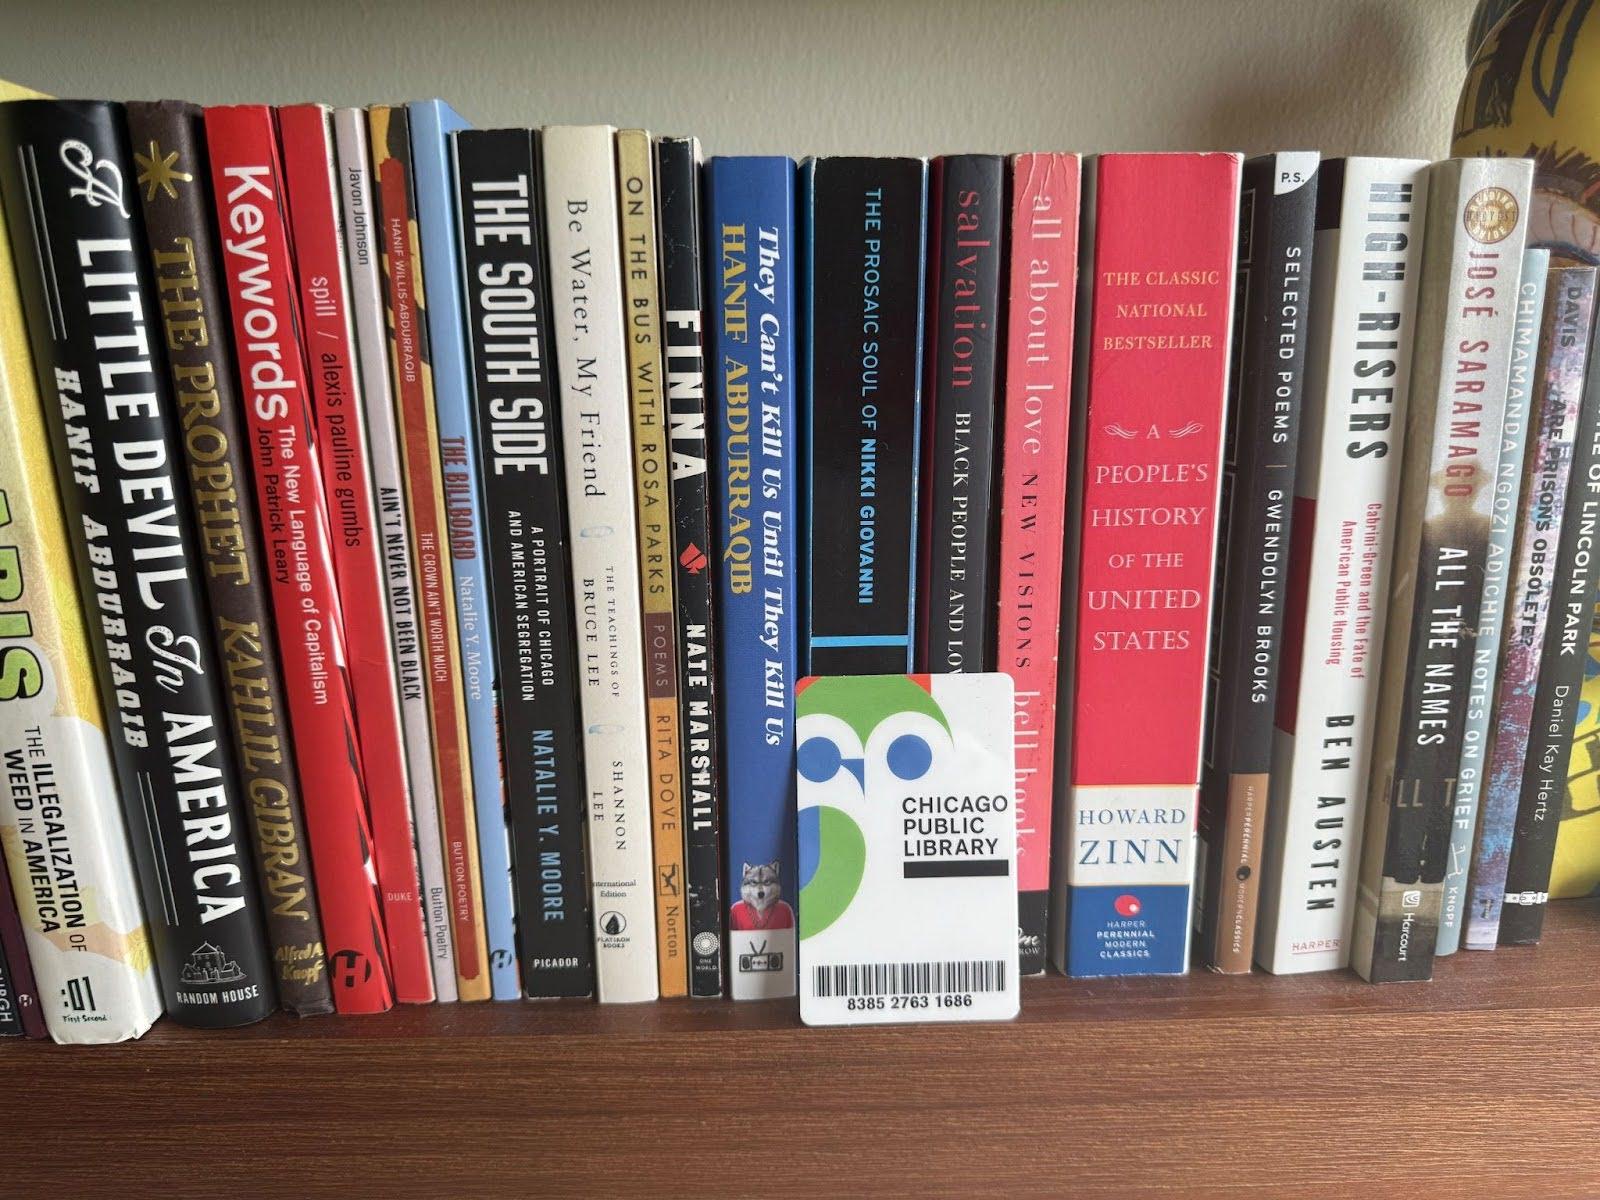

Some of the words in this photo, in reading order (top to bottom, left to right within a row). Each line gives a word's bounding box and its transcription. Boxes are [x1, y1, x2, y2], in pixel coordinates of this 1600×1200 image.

[348, 167, 363, 206] Javon
[1281, 172, 1305, 184] P.S.
[353, 210, 368, 265] Johnson
[391, 218, 403, 257] HANIF
[567, 200, 589, 232] Be
[1031, 194, 1061, 239] all
[223, 165, 288, 419] Keywords
[722, 223, 747, 343] HANIF
[758, 225, 782, 304] They
[863, 238, 881, 335] PROSAIC
[951, 190, 990, 387] salvation
[1146, 269, 1219, 286] CLASSIC
[1462, 252, 1499, 319] JOSÉ
[310, 277, 337, 317] spill
[479, 262, 541, 381] SOUTH
[569, 247, 591, 341] Water,
[632, 298, 651, 343] BUS
[1026, 258, 1059, 366] about
[1116, 302, 1208, 318] NATIONAL
[1279, 247, 1301, 360] SELECTED
[1346, 183, 1413, 460] HIGH-RISERS
[1560, 287, 1581, 347] DAVIS
[77, 237, 160, 420] LITTLE
[760, 312, 784, 394] Can't
[1103, 334, 1213, 351] BESTSELLER
[321, 352, 342, 406] alexis
[635, 361, 655, 426] WITH
[862, 343, 879, 396] SOUL
[1503, 282, 1537, 450] CHIMAMANDA
[664, 309, 707, 481] FINNA
[1021, 382, 1054, 455] love
[1272, 371, 1293, 443] POEMS
[1446, 340, 1489, 498] SARAMAGO
[257, 426, 273, 468] John
[323, 414, 351, 481] pauline
[489, 398, 548, 474] SIDE
[580, 412, 606, 497] Friend
[762, 401, 783, 457] Kill
[951, 412, 971, 486] BLACK
[640, 443, 659, 508] ROSA
[725, 356, 752, 594] ABDURRAQIB
[860, 438, 877, 497] NIKKI
[1095, 463, 1208, 483] PEOPLE'S
[1534, 447, 1561, 532] PRISONS
[113, 438, 188, 610] DEVIL
[263, 475, 282, 532] Patrick
[334, 485, 360, 546] gumbs
[381, 488, 402, 526] AIN'T
[440, 468, 477, 560] BILLBOARD
[1091, 507, 1206, 527] HISTORY
[1494, 463, 1515, 531] NGOZI
[54, 366, 100, 493] HANIF
[82, 514, 148, 748] ABDURRAQIB
[269, 538, 288, 584] Leary
[387, 534, 407, 579] NEVER
[644, 524, 664, 593] PARKS
[763, 509, 784, 580] Until
[858, 504, 876, 604] GIOVANNI
[949, 496, 968, 583] PEOPLE
[1260, 489, 1284, 614] GWENDOLYN
[1338, 521, 1357, 576] American
[1359, 503, 1382, 586] Cabrini-Green
[1570, 501, 1599, 594] LINCOLN
[423, 554, 438, 589] CROWN
[510, 542, 529, 609] AMERICAN
[531, 539, 549, 604] PORTRAIT
[1436, 546, 1467, 592] ALL
[1475, 535, 1505, 637] ADICHIE
[290, 510, 312, 595] Language
[305, 620, 327, 704] Capitalism
[460, 576, 478, 630] Natalie
[583, 579, 598, 642] BRUCE
[762, 587, 784, 652] They
[1015, 550, 1037, 668] VISIONS
[1087, 589, 1201, 610] UNITED
[1334, 582, 1351, 615] Public
[174, 361, 250, 586] PROPHET
[218, 615, 281, 771] KAHLIL
[250, 777, 309, 919] GIBRAN
[397, 622, 416, 654] BEEN
[429, 618, 445, 652] WORTH
[515, 614, 535, 701] SEGREGATION
[607, 599, 618, 676] TEACHINGS
[652, 624, 669, 688] POEMS
[686, 623, 707, 687] NATE
[1093, 630, 1190, 651] STATES
[1326, 621, 1348, 665] Housing
[1352, 639, 1368, 662] Fate
[1559, 602, 1583, 656] PARK
[400, 661, 421, 700] BLACK
[433, 655, 447, 681] MUCH
[466, 651, 482, 700] Moore
[538, 630, 555, 686] CHICAGO
[587, 654, 600, 687] LEE
[765, 658, 784, 707] Kill
[1252, 626, 1271, 703] BROOKS
[1466, 649, 1491, 719] NOTES
[1014, 691, 1040, 748] bell
[1416, 664, 1455, 746] NAMES
[1549, 685, 1568, 738] Daniel
[656, 714, 671, 758] RITA
[1321, 714, 1354, 770] BEN
[1540, 744, 1558, 774] Kay
[532, 729, 557, 814] NATALIE
[687, 701, 713, 831] MARSHALL
[162, 711, 246, 925] AMERICA
[593, 792, 604, 822] LEE
[612, 760, 627, 851] SHANNON
[659, 773, 675, 830] DOVE
[902, 796, 1008, 814] CHICAGO
[903, 817, 984, 835] PUBLIC
[1078, 808, 1185, 826] HOWARD
[1453, 768, 1476, 830] GRIEF
[1534, 778, 1553, 821] Hertz
[2, 749, 36, 814] WEED
[22, 838, 61, 933] AMERICA
[32, 762, 86, 928] ILLEGALIZATION
[452, 841, 465, 882] BUTTON
[904, 837, 998, 856] LIBRARY
[1078, 839, 1183, 865] ZINN
[1306, 796, 1346, 910] AUSTEN
[430, 886, 443, 921] Button
[457, 883, 470, 922] POETRY
[540, 852, 564, 921] MOORE
[433, 923, 448, 959] Poetry
[666, 906, 679, 957] Norton
[1097, 930, 1154, 939] PERENNIAL
[1105, 940, 1146, 949] MODERN
[1106, 920, 1145, 929] HARPER
[1292, 939, 1340, 951] HARPER
[1398, 913, 1415, 961] Harcourt
[534, 957, 578, 968] PICADOR
[1100, 949, 1149, 958] CLASSICS
[176, 990, 219, 1004] RANDOM
[222, 984, 259, 1003] HOUSE
[847, 996, 885, 1010] 8385
[890, 995, 928, 1009] 2763
[934, 994, 973, 1007] 1686
